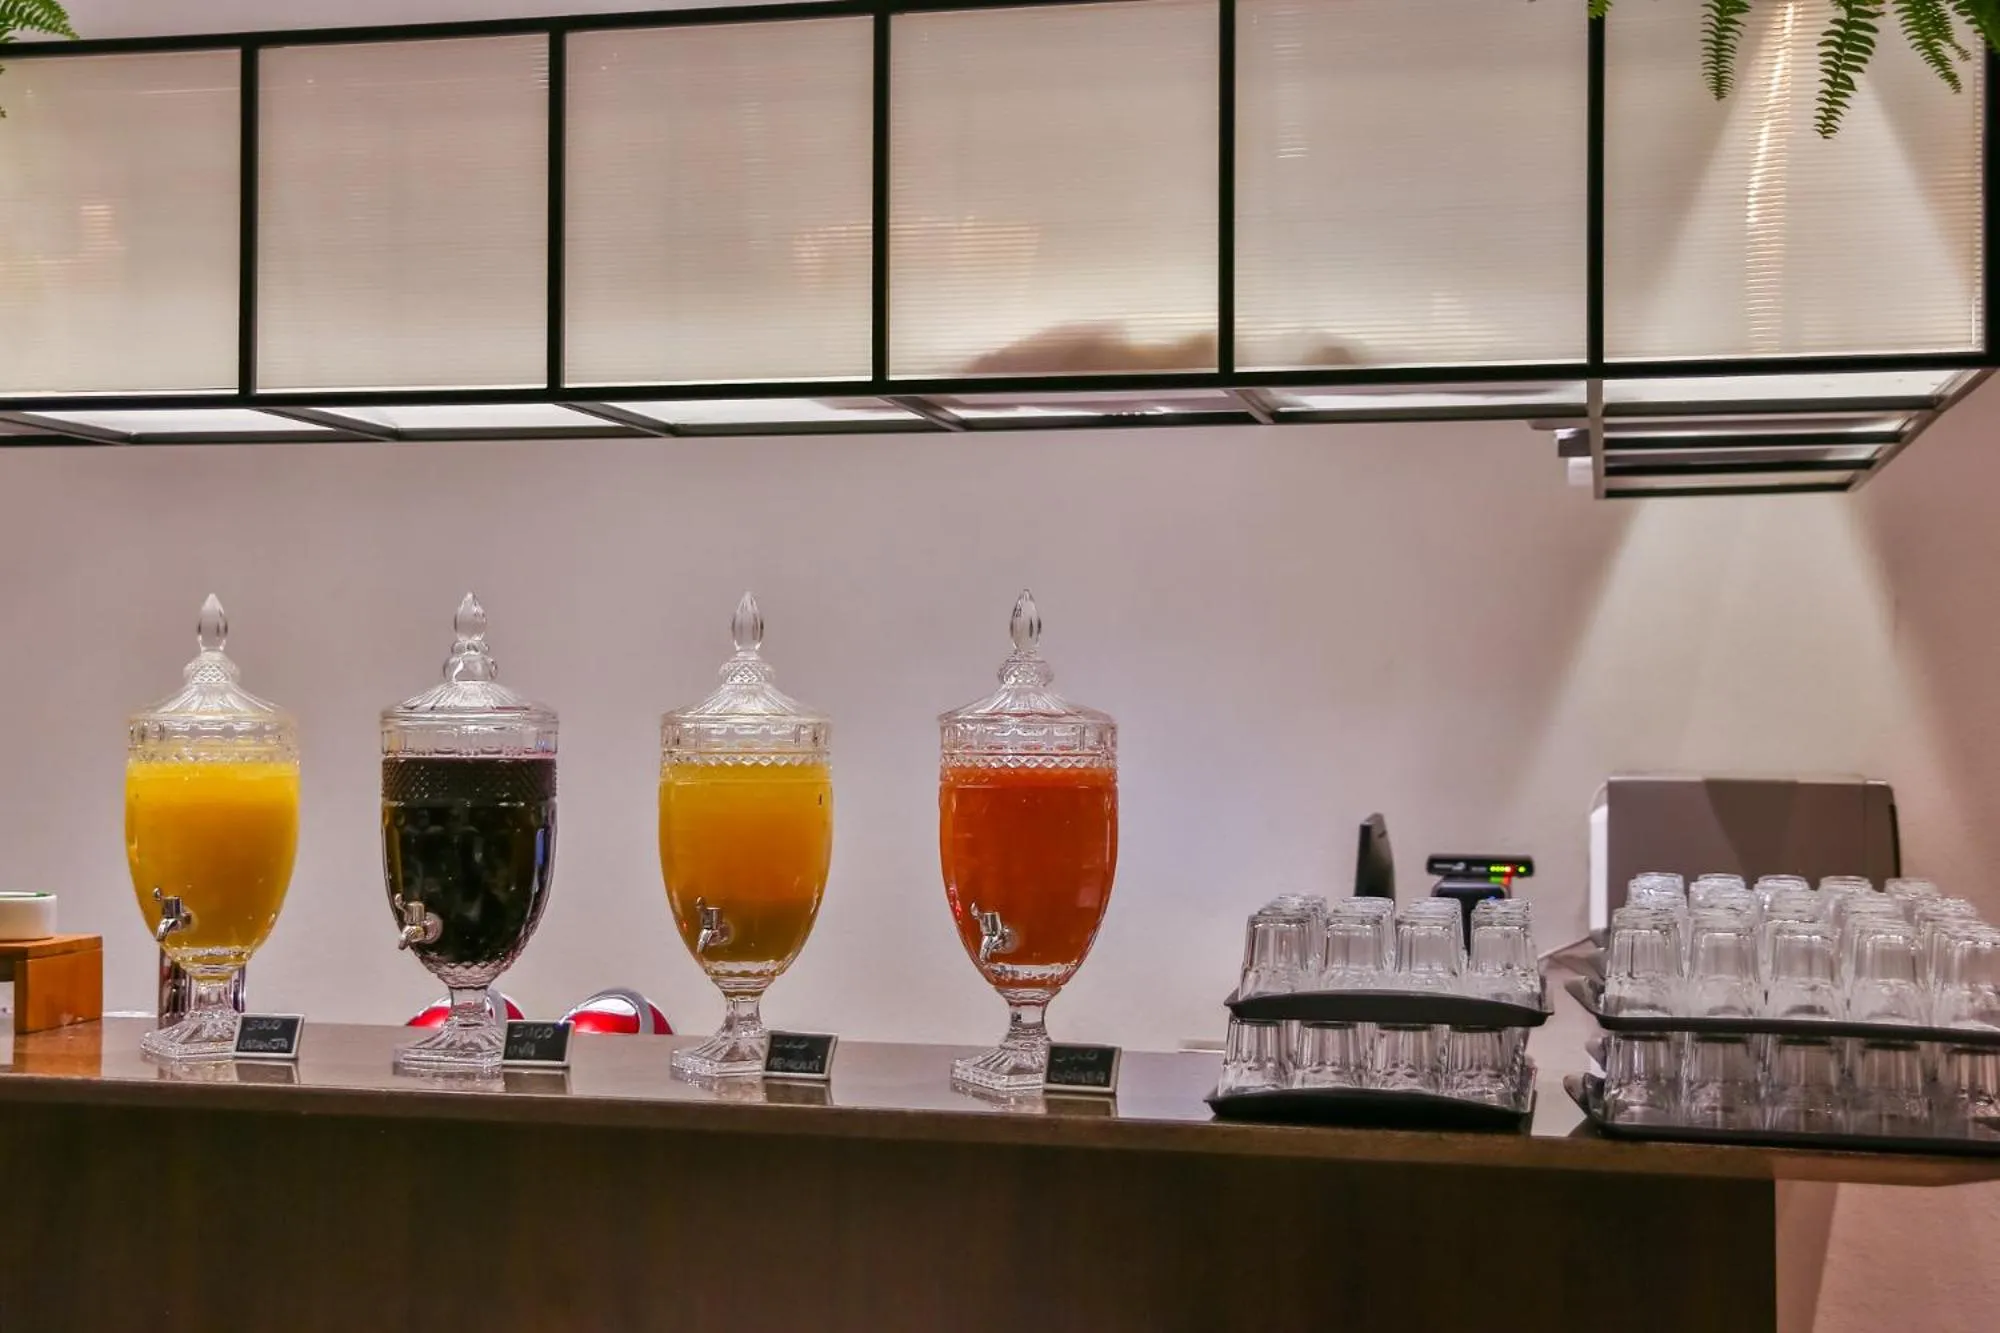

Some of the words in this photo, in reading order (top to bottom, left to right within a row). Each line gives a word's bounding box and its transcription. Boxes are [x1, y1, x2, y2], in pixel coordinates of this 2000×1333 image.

[246, 1019, 282, 1031] SUCO
[511, 1025, 554, 1040] SUCO
[507, 1041, 536, 1057] UVA
